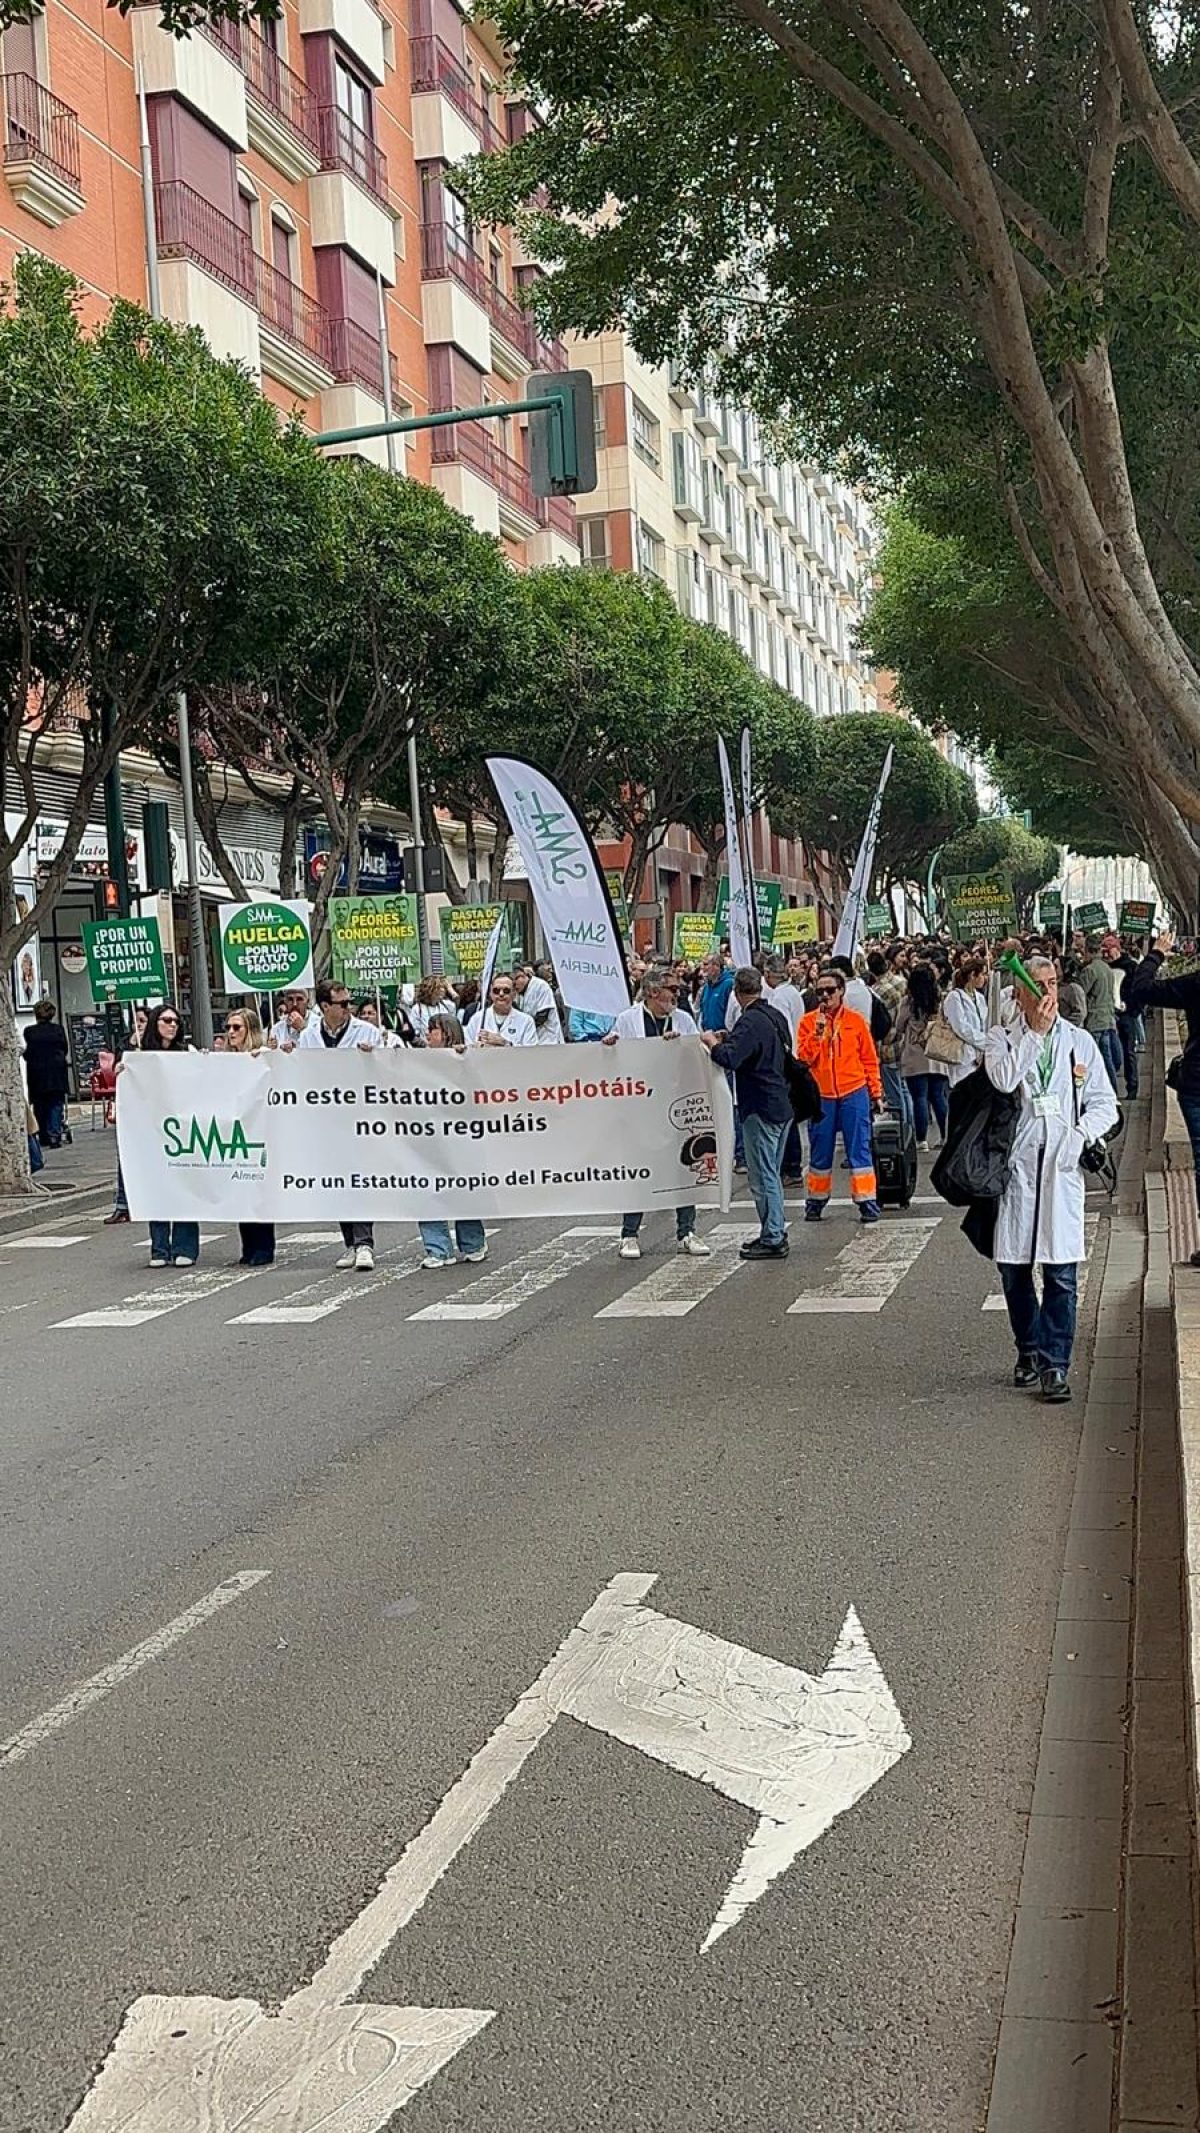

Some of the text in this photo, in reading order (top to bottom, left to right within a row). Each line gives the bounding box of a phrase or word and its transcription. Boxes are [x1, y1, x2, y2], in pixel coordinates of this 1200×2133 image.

[961, 885, 999, 896] PEORES
[952, 894, 1012, 906] CONDICIONES
[247, 908, 281, 923] SMA
[352, 913, 400, 926] PEORES
[452, 908, 499, 920] BASTA DE
[987, 909, 1000, 917] UN
[452, 919, 497, 930] PARCHES
[96, 926, 147, 944] ¡POR UN
[228, 925, 304, 944] HUELGA
[337, 926, 415, 940] CONDICIONES
[448, 931, 492, 941] QUEREMO
[92, 941, 154, 959] ESTATUTO
[245, 943, 288, 960] POR UN
[356, 944, 398, 958] ¡POR UN
[453, 940, 488, 950] ESTATU
[238, 952, 297, 965] ESTATUTO
[344, 957, 414, 969] MARCO LEGAL
[100, 957, 152, 975] PROPIO!
[247, 962, 290, 974] PROPIO
[359, 968, 397, 980] JUSTO!
[305, 1087, 356, 1105] este
[364, 1085, 465, 1105] Estatuto
[473, 1087, 519, 1105] nos
[527, 1077, 653, 1105] explotáis,
[686, 1097, 704, 1106] NO
[356, 1113, 547, 1139] no nos reguláis
[163, 1114, 265, 1162] SMA
[283, 1165, 650, 1191] Por un Estatuto propio del Facultativo
